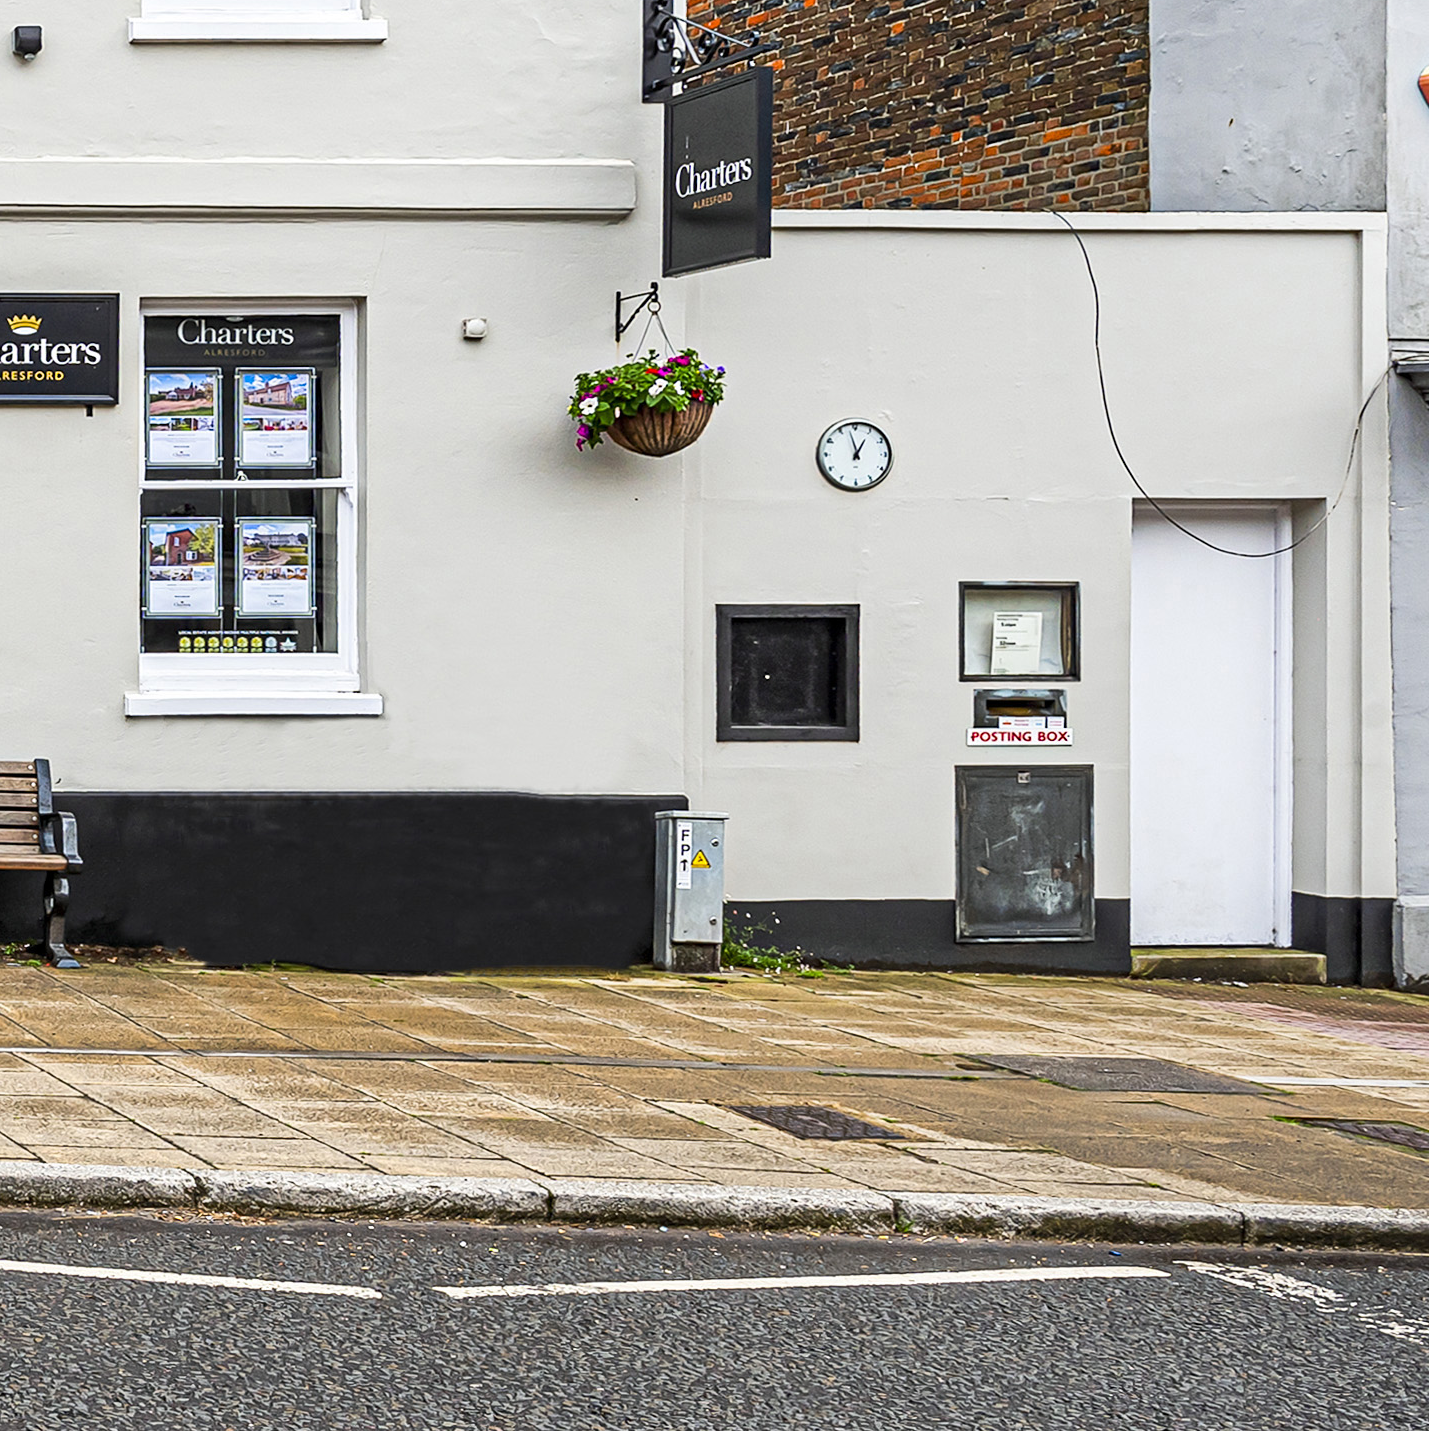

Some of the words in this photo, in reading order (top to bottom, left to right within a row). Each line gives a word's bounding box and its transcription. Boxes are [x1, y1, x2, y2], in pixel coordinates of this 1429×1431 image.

[675, 157, 752, 198] Charters
[692, 191, 733, 210] ALRESFORD
[177, 318, 295, 345] Charters
[203, 348, 266, 357] ALRESFORD
[972, 731, 1032, 742] POSTING
[1037, 731, 1068, 742] BOX
